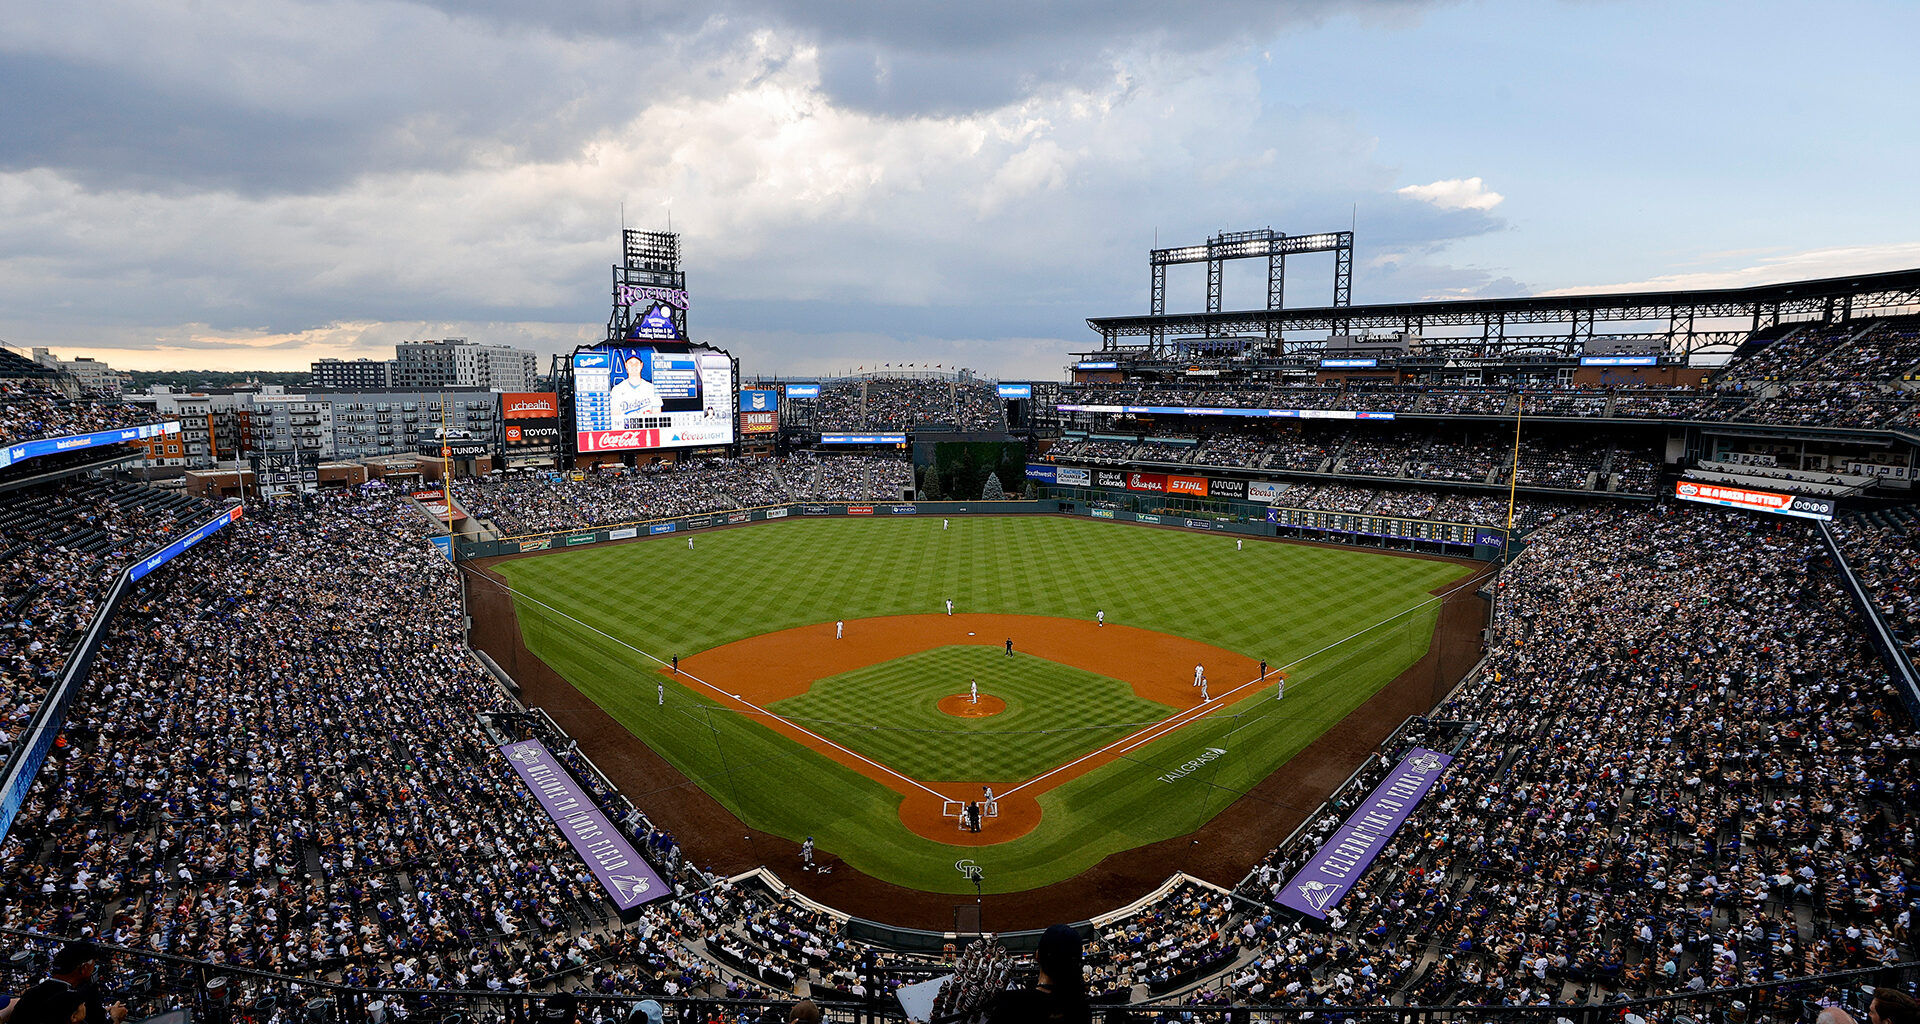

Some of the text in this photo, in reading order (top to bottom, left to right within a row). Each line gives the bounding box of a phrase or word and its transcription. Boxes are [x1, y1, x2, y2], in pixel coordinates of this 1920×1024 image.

[618, 286, 689, 310] ROCKIES
[1457, 360, 1481, 368] Silver
[511, 400, 551, 411] uchealth
[748, 414, 772, 424] KING
[524, 428, 558, 437] TOYOTA
[681, 431, 704, 441] Coors
[598, 431, 641, 448] Coca-Cola
[453, 446, 486, 455] TUNDRA
[1025, 470, 1052, 479] Southwest
[1099, 472, 1122, 480] Bank of
[1098, 479, 1126, 489] Colorado
[1172, 480, 1203, 491] STIHL
[1220, 490, 1233, 498] Years
[1249, 486, 1271, 497] Coors
[1481, 534, 1504, 547] xfinity
[527, 763, 569, 799] WELCOME
[554, 797, 580, 813] TO
[565, 810, 603, 841] COORS
[1319, 772, 1426, 879] CELEBRATING 30 YEARS
[588, 838, 629, 872] FIELD
